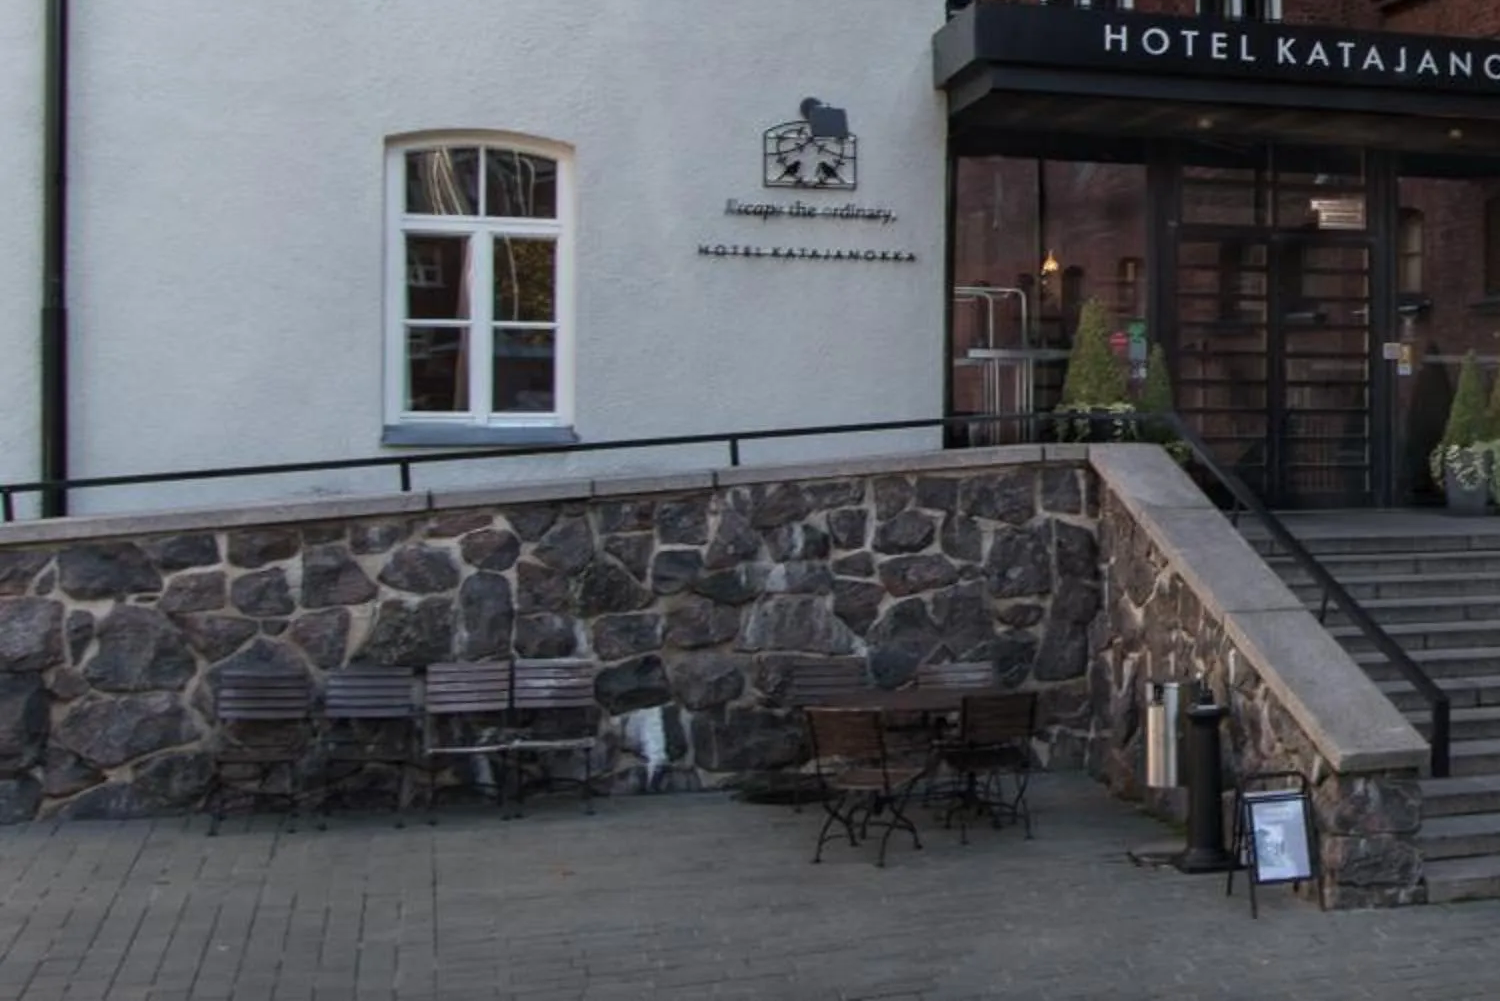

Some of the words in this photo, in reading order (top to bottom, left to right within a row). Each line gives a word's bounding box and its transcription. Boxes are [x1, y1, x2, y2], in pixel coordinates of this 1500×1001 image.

[1104, 24, 1256, 62] HOTEL
[788, 200, 817, 218] the
[698, 245, 762, 258] HOTEL
[771, 248, 917, 263] KATAJANOKKA
